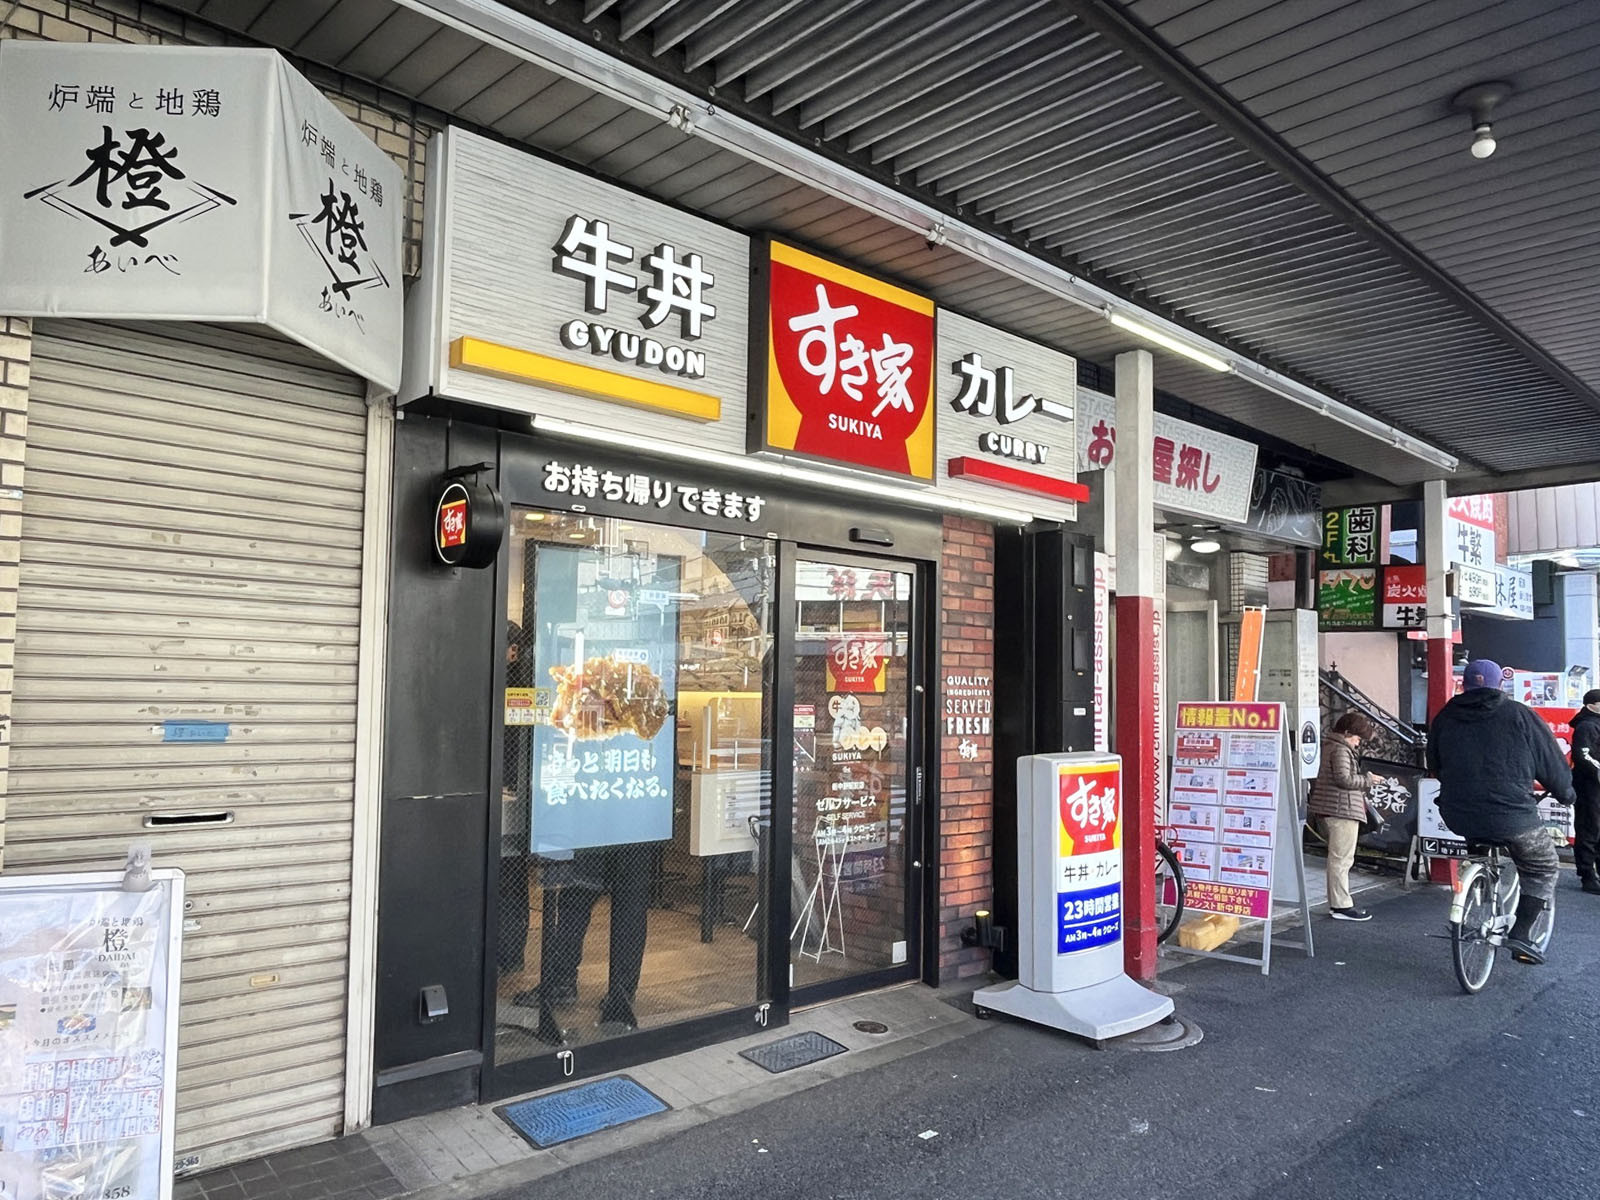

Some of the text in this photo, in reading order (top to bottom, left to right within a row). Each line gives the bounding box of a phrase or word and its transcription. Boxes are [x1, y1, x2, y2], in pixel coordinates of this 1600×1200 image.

[48, 84, 222, 118] 炉端と地鶏
[68, 126, 187, 211] 橙
[301, 119, 384, 207] 炉端と地鶏
[311, 178, 369, 275] 橙
[553, 215, 716, 340] 牛丼
[561, 319, 706, 378] GYUDON
[788, 284, 915, 417] すき家
[951, 353, 1074, 424] カレー
[828, 413, 883, 441] SUKIYA
[980, 431, 1050, 464] CURRY
[1088, 420, 1220, 494] お屋探し
[543, 461, 767, 522] お持ち帰りできます
[1326, 512, 1340, 548] 2F
[1345, 507, 1376, 563] 歯科
[946, 675, 990, 686] QUALITY
[946, 688, 991, 697] INGREDIENTS
[946, 699, 991, 714] SERVED
[1181, 706, 1276, 728] 情報量No.1
[946, 716, 990, 735] FRESH
[547, 748, 657, 774] きっと明日も
[831, 752, 862, 761] SUKIYA
[546, 776, 668, 806] 食べたくなる。
[816, 796, 877, 812] セルフサービス
[1066, 776, 1117, 830] すき家
[1063, 892, 1120, 921] 23時間営業
[1184, 890, 1254, 906] 気軽にご相談下さい。
